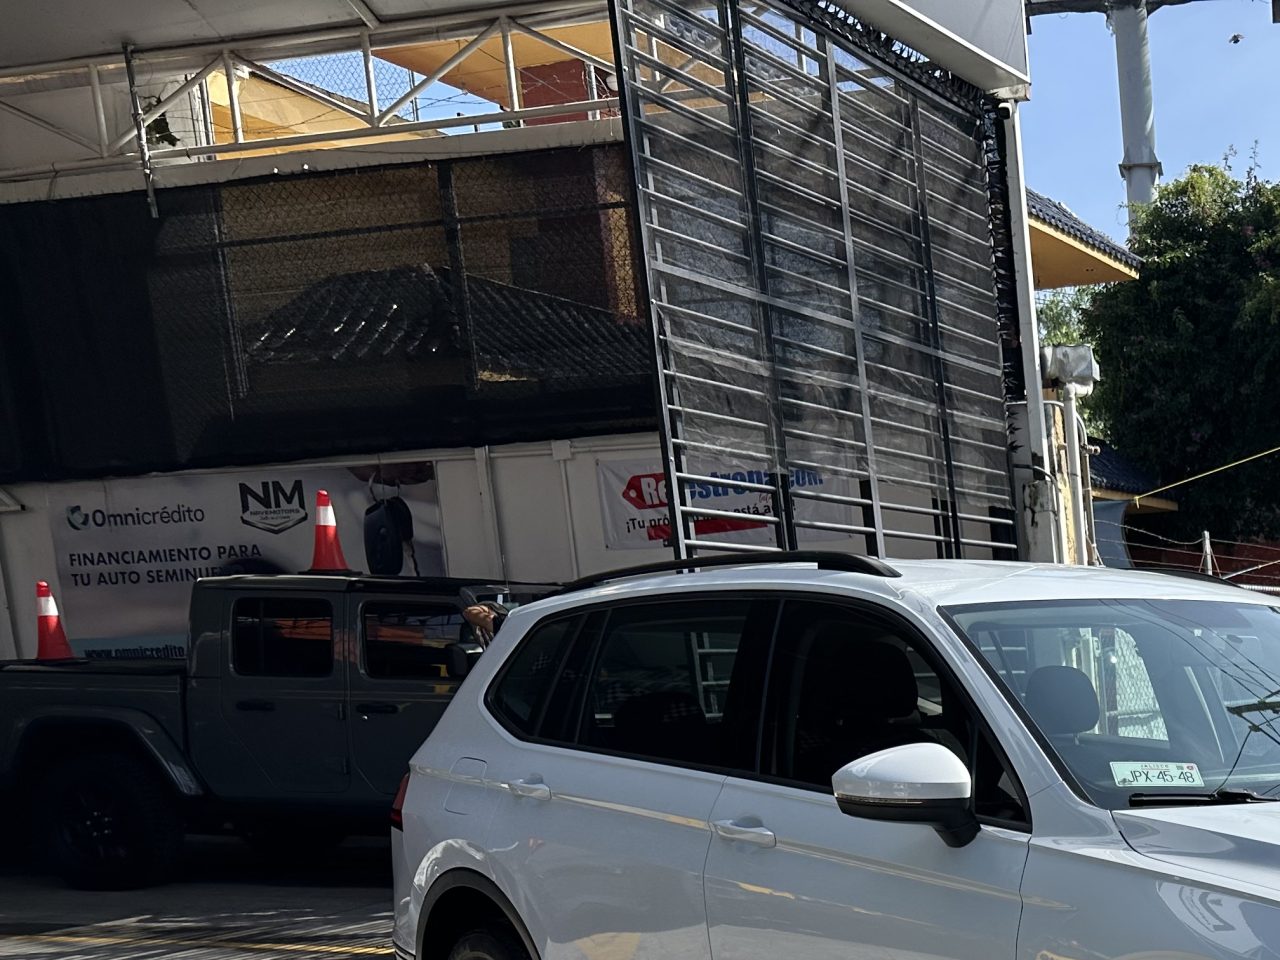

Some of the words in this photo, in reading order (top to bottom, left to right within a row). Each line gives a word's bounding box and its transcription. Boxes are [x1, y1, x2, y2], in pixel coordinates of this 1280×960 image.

[239, 480, 306, 514] NM
[92, 504, 205, 527] Omnicrédito
[69, 547, 212, 567] FINANCIAMIENTO
[217, 543, 263, 560] PARA
[71, 573, 91, 586] TU
[97, 570, 141, 586] AUTO
[1127, 770, 1195, 783] JPX-45-48
